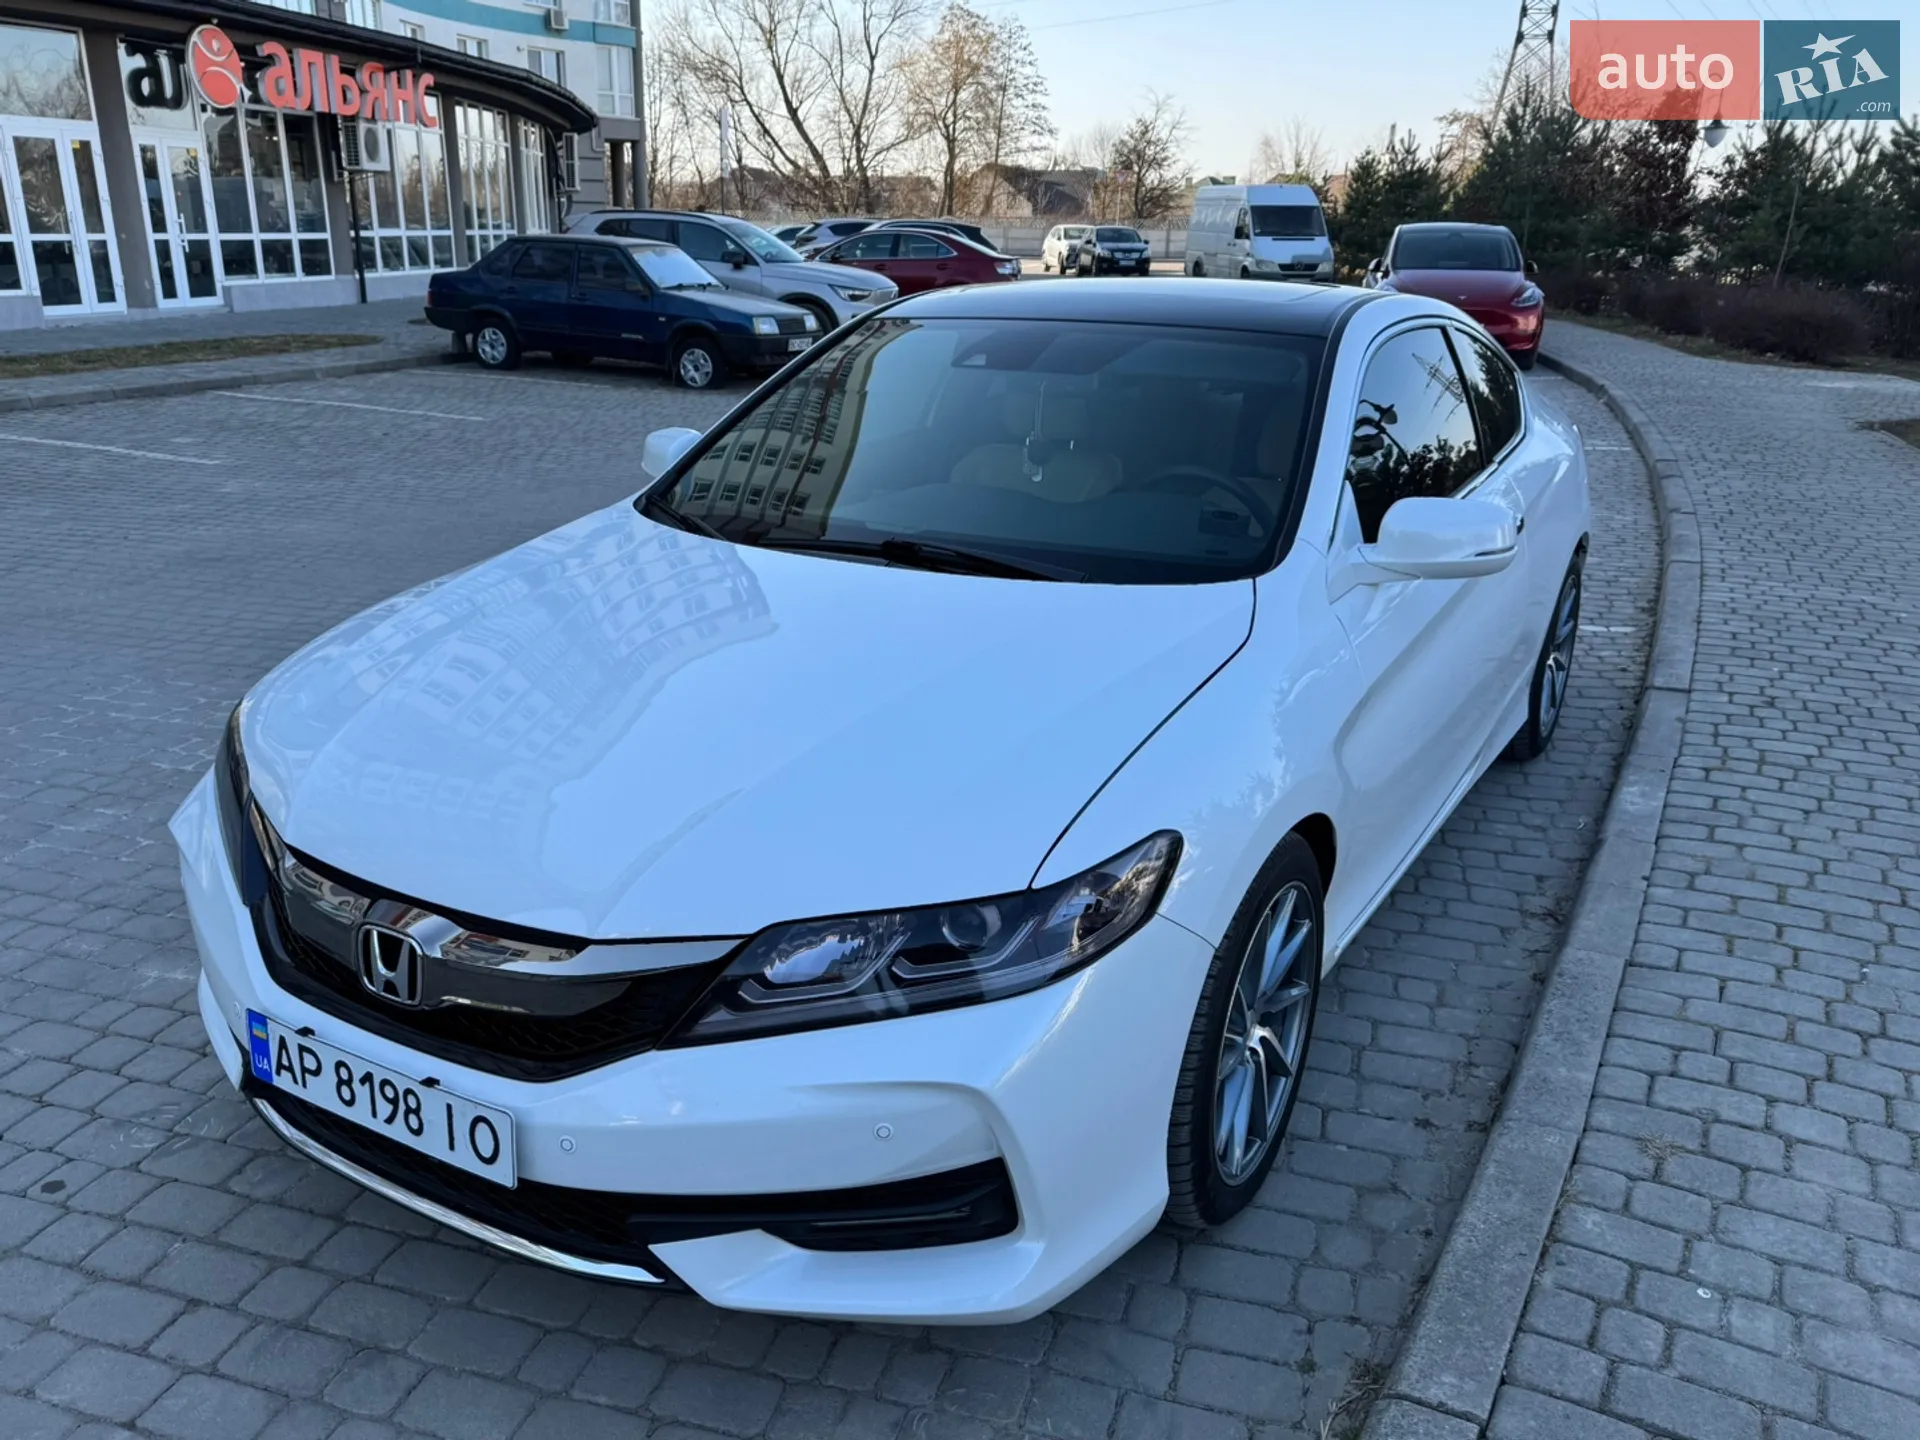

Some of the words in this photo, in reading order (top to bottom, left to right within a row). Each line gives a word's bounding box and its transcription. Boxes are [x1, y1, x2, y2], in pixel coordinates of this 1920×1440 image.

[254, 1052, 271, 1073] UA
[274, 1034, 323, 1090] AP
[334, 1059, 425, 1138] 8198
[445, 1101, 501, 1166] IO
